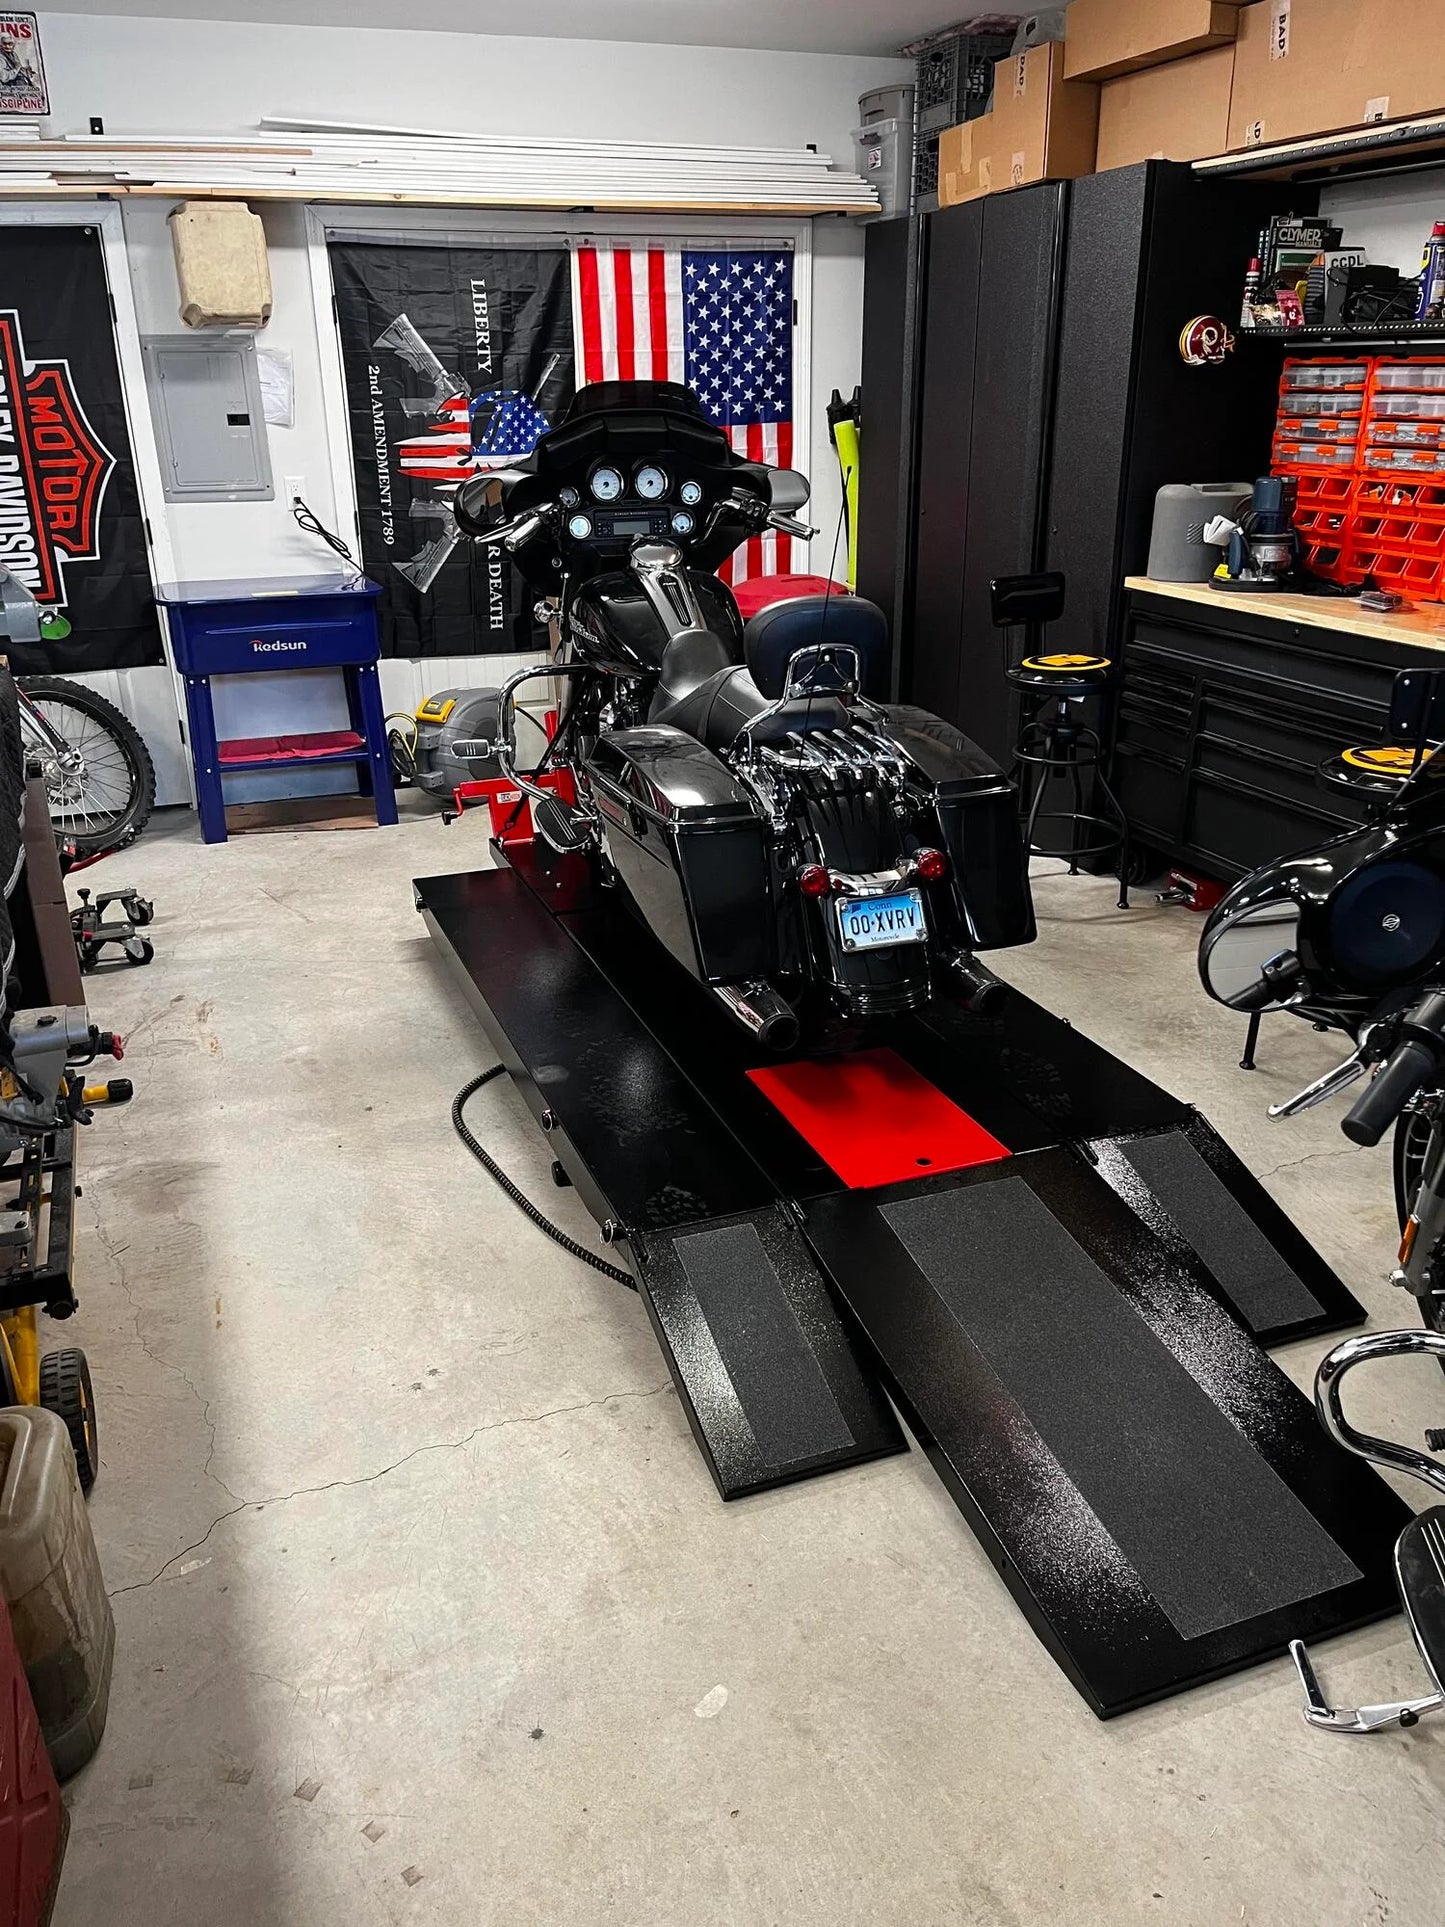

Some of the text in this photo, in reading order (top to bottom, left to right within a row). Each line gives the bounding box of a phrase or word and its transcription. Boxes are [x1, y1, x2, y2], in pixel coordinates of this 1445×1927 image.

[1278, 14, 1287, 50] BAD
[1279, 228, 1322, 241] CLYMER
[471, 279, 492, 375] LIBERTY
[28, 396, 89, 529] MOTOR
[368, 364, 395, 546] 2nd AMENDMENT 1789
[487, 544, 504, 630] R DEATH
[252, 640, 307, 652] Redsun
[867, 902, 893, 911] Conn
